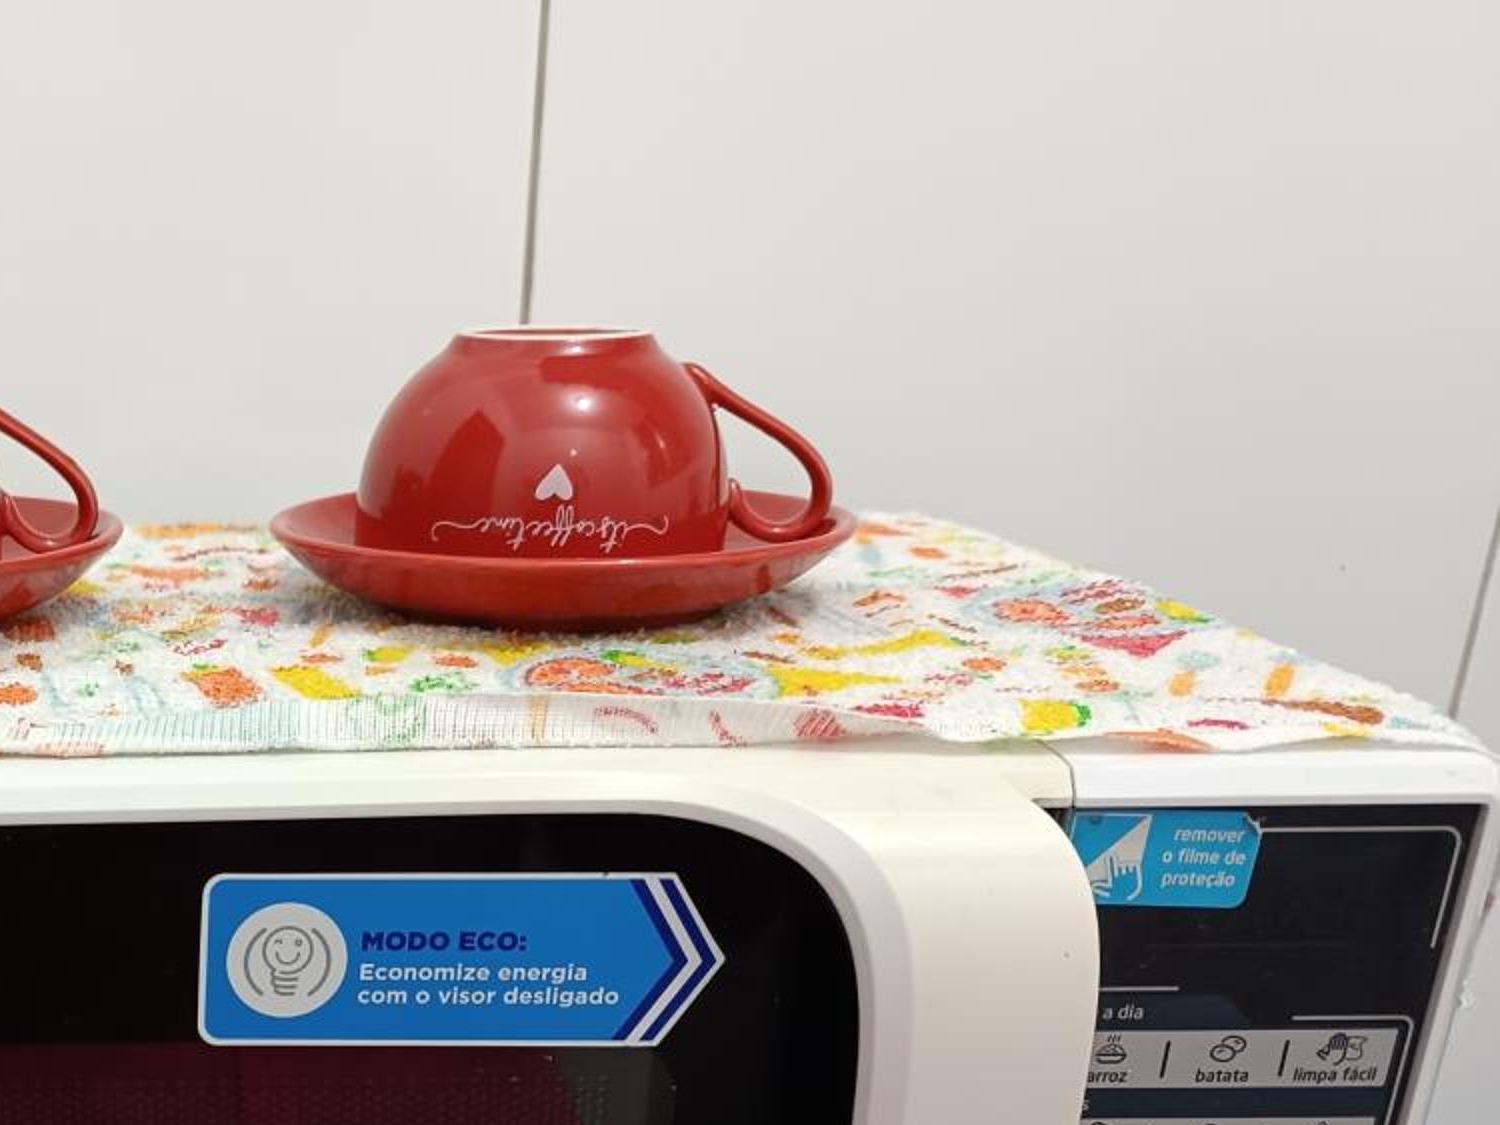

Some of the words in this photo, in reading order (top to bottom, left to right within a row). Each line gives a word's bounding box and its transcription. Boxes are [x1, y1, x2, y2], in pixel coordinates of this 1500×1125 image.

[1174, 830, 1246, 843] remover
[1162, 852, 1173, 864] o
[1178, 848, 1221, 865] filme
[1225, 850, 1246, 865] de
[1160, 871, 1236, 889] proteção
[361, 931, 450, 951] MODO
[458, 931, 527, 951] ECO:
[358, 963, 490, 982] Economize
[497, 963, 588, 987] energia
[357, 989, 408, 1005] com
[415, 989, 431, 1005] o
[438, 986, 497, 1005] visor
[503, 986, 620, 1009] desligado
[1102, 1007, 1113, 1020] a
[1118, 1004, 1145, 1020] dia
[1195, 1068, 1249, 1083] batata
[1292, 1067, 1338, 1085] limpa
[1341, 1066, 1377, 1083] fácil
